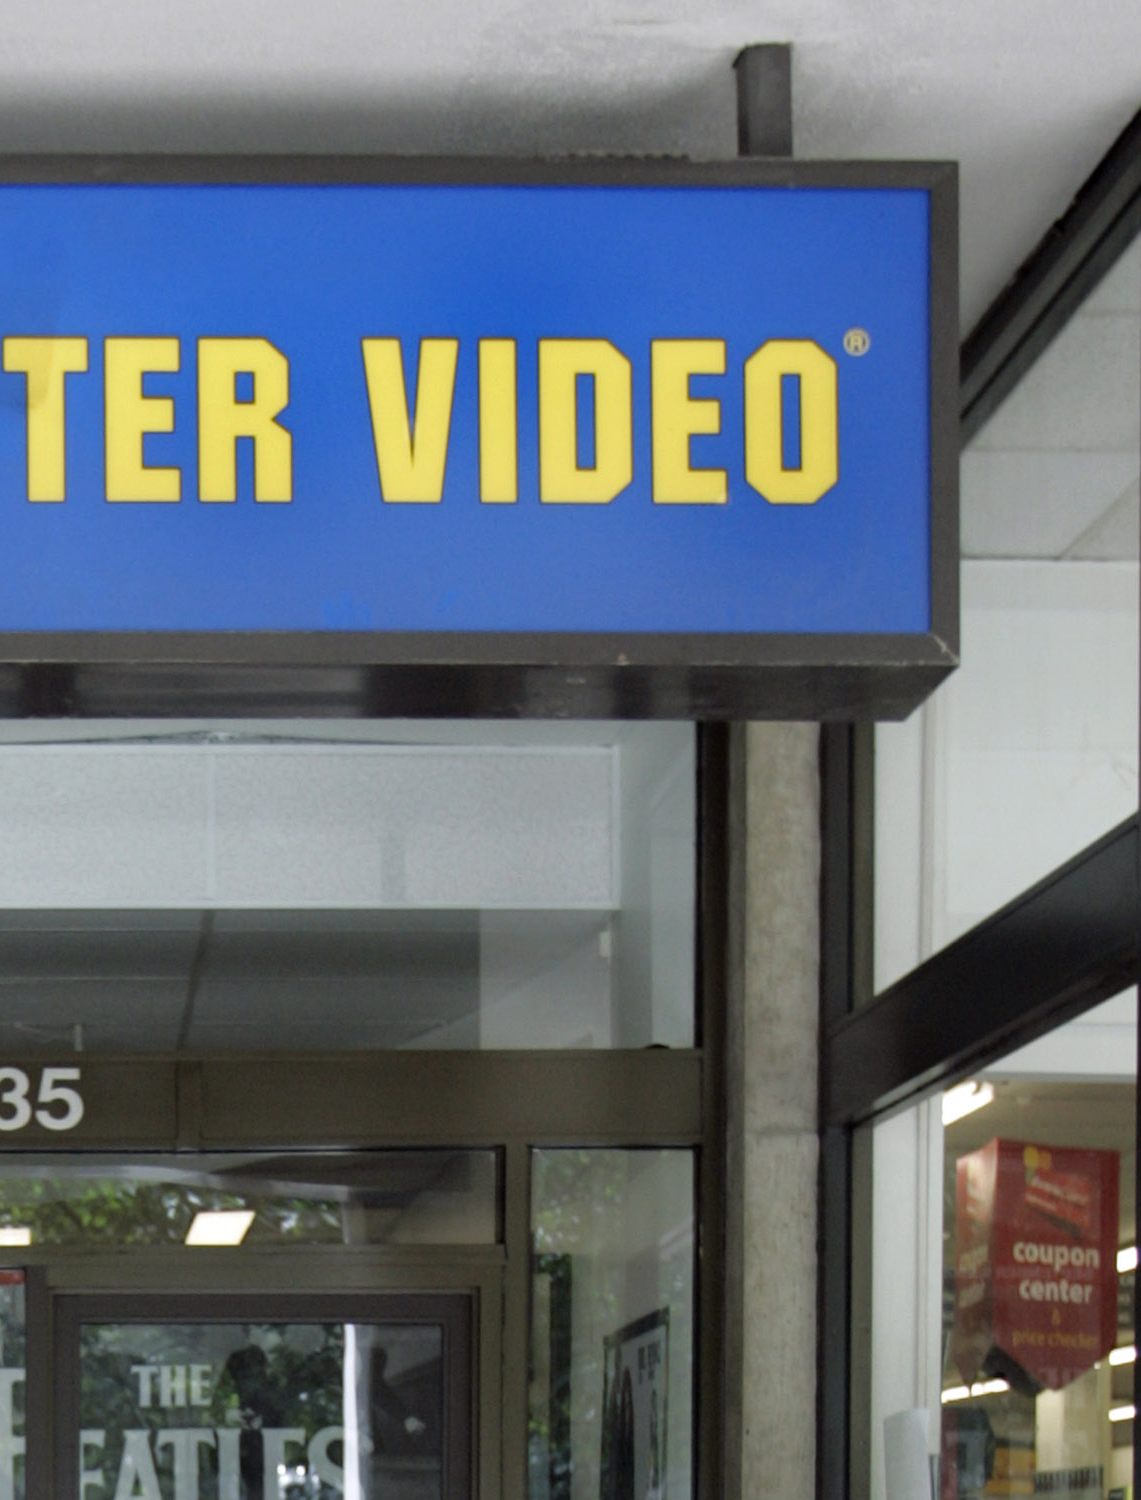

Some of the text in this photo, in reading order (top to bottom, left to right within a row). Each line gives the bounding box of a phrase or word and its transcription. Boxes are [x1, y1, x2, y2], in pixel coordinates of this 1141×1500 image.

[1012, 1241, 1100, 1270] coupon
[1018, 1278, 1092, 1304] center
[131, 1365, 213, 1407] THE
